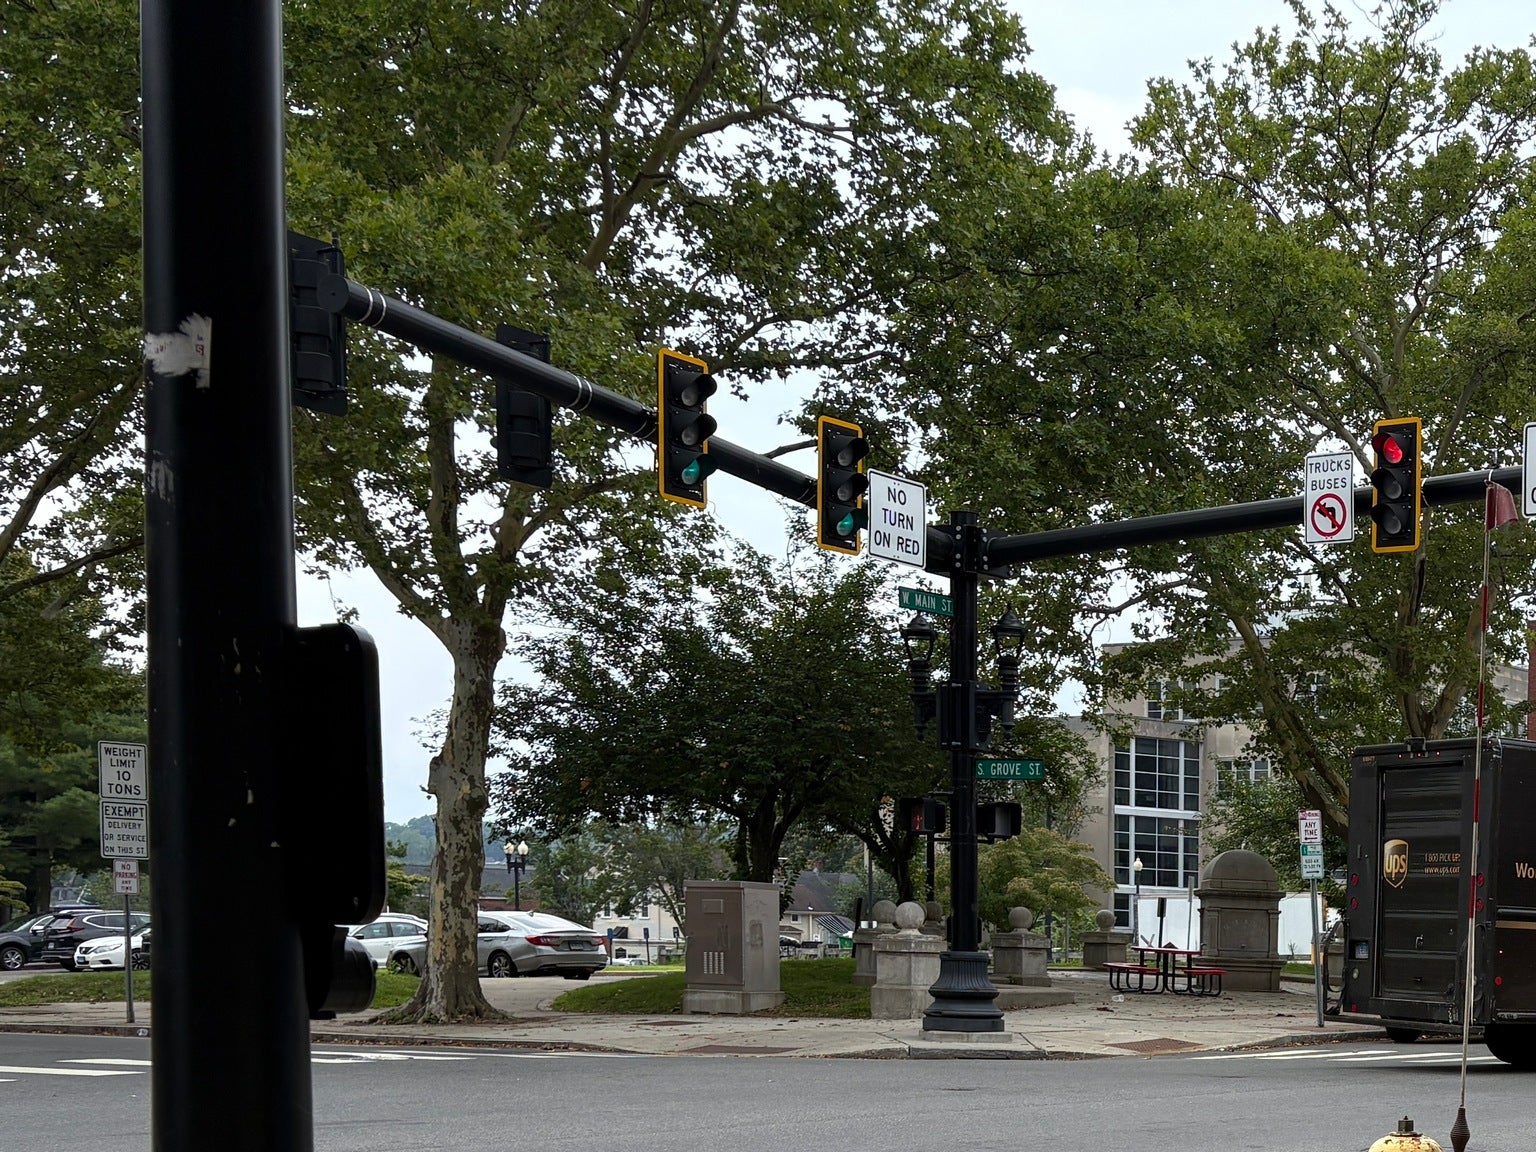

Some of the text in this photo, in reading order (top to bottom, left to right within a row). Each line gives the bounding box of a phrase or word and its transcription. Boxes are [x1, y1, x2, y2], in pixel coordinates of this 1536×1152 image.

[1308, 459, 1351, 474] TRUCKS
[1311, 477, 1347, 491] BUSES
[887, 486, 907, 505] NO
[881, 507, 914, 531] TURN
[874, 530, 920, 556] ON RED
[914, 593, 936, 609] MAIN
[104, 746, 142, 758] WEIGHT
[110, 758, 136, 768] LIMIT
[990, 762, 1022, 776] GROVE
[117, 770, 131, 781] 10
[107, 783, 141, 796] TONS
[104, 805, 144, 817] EXEMPT
[108, 821, 141, 829] DELIVERY
[117, 834, 145, 842] SERVICE
[118, 846, 133, 854] THIS
[1386, 853, 1406, 880] ups
